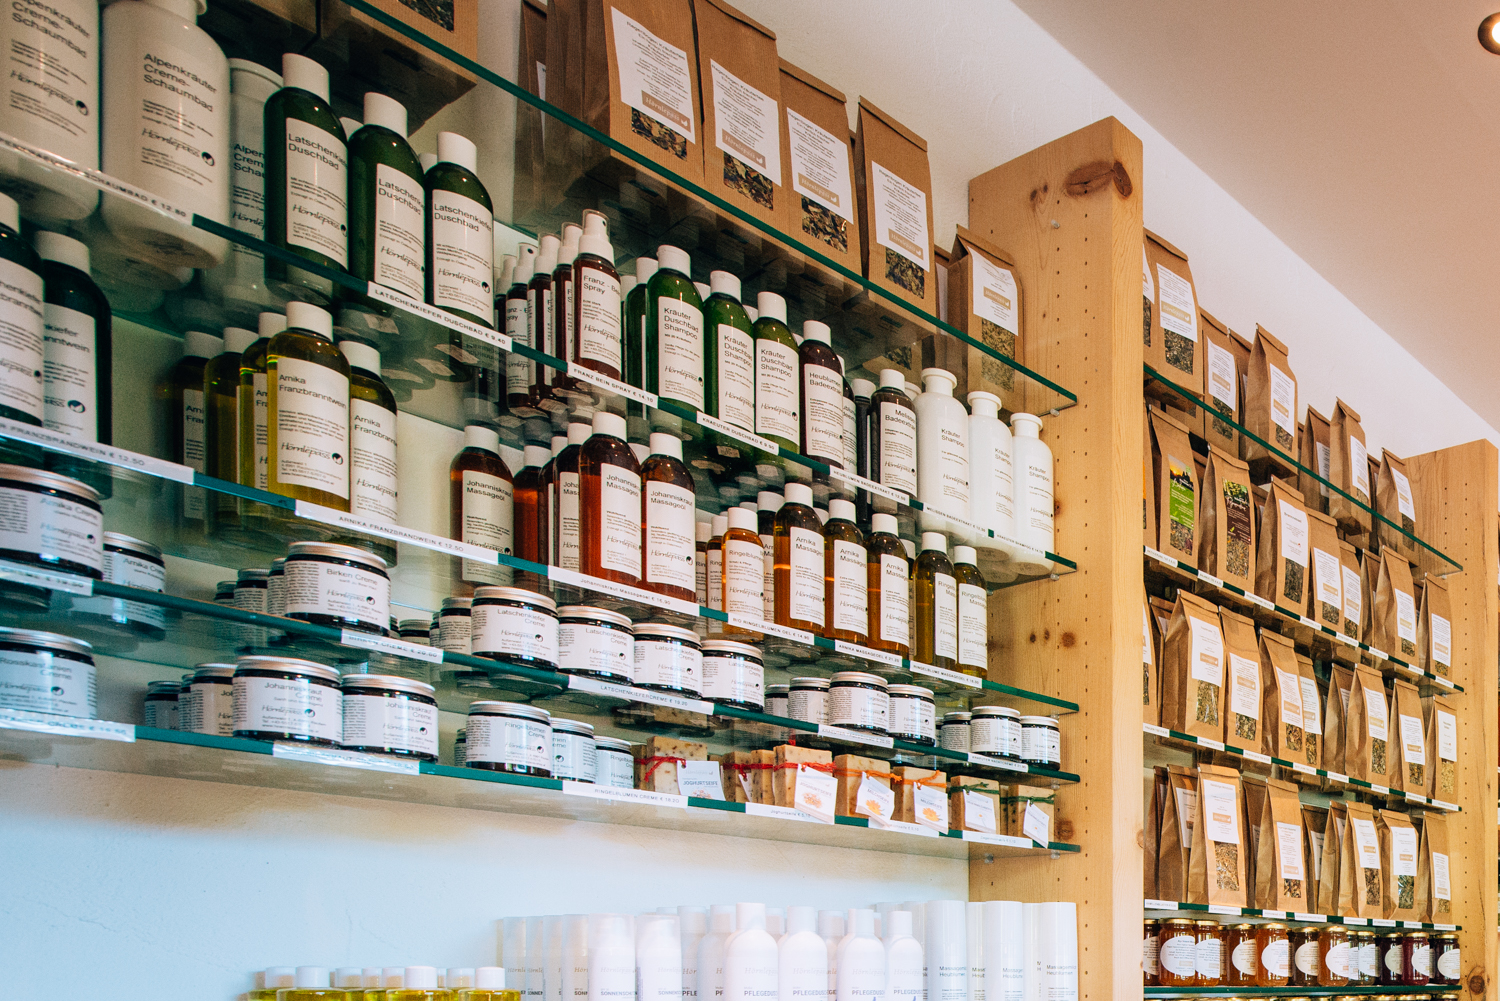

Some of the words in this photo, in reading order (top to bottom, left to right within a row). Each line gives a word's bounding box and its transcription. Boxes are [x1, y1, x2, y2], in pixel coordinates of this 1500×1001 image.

[12, 2, 64, 30] Creme-
[12, 13, 87, 59] Schaumbad
[143, 53, 218, 94] Alpenkräuter
[143, 64, 190, 88] Creme-
[143, 74, 214, 113] Schaumbad
[288, 143, 340, 171] Duschbad
[434, 213, 480, 232] Duschbad
[583, 282, 606, 296] Spray
[374, 288, 443, 320] LATSCHENKIEFER
[443, 315, 483, 337] DUSCHBAD
[664, 307, 692, 321] Kräuter
[664, 315, 699, 334] Duschbad
[664, 323, 698, 341] Shampoo
[724, 334, 748, 350] Kräuter
[761, 348, 786, 361] Kräuter
[761, 356, 793, 373] Duschbad
[761, 364, 792, 379] Shampoo
[279, 374, 307, 385] Arnika
[573, 368, 595, 382] FRANZ
[595, 376, 613, 389] BEIN
[613, 382, 632, 396] SPRAY
[279, 384, 347, 409] Franzbranntwein
[354, 414, 381, 428] Arnika
[941, 428, 961, 440] Kräuter
[941, 434, 965, 448] Shampoo
[467, 479, 511, 498] Johanniskraut
[467, 487, 506, 502] Massageöl
[650, 490, 693, 507] Johanniskraut
[650, 497, 687, 510] Massageöl
[795, 536, 816, 546] Arnika
[840, 548, 860, 558] Arnika
[886, 562, 904, 572] Arnika
[327, 568, 353, 579] Birken
[355, 573, 378, 586] Creme
[498, 608, 546, 623] Latschenkiefer
[524, 617, 546, 628] Creme
[585, 627, 628, 641] Latschenkiefer
[610, 637, 628, 647] Creme
[412, 711, 432, 721] Creme
[528, 731, 546, 740] Creme
[594, 788, 637, 799] RINGELBLUMEN
[638, 793, 658, 801] CREME
